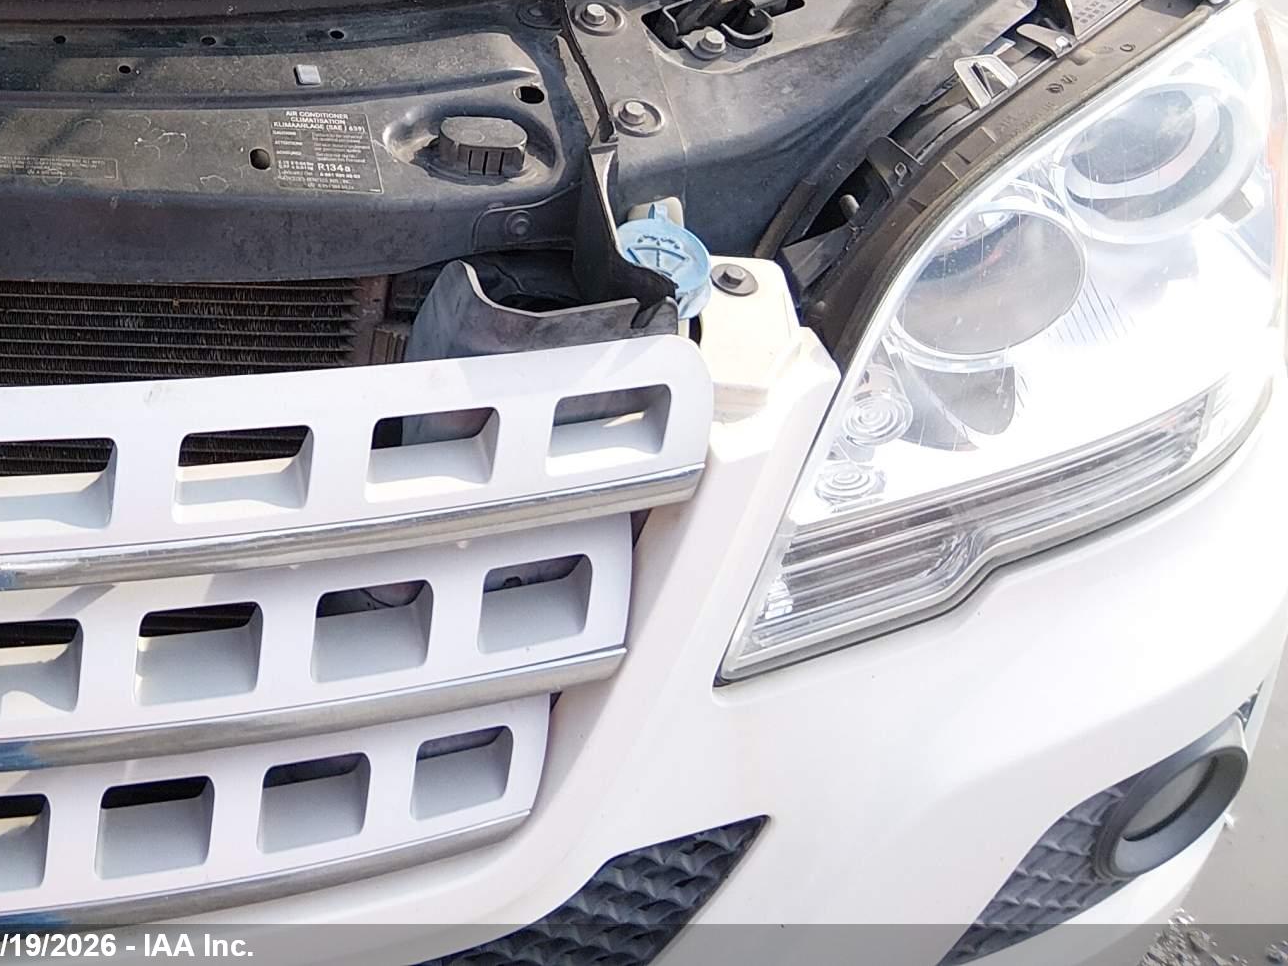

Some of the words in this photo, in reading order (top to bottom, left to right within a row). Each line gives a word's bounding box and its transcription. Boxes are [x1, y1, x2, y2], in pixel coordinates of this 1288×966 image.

[300, 111, 349, 120] CONDITIONER
[290, 116, 346, 125] CLIMATISATION
[273, 121, 325, 130] KLIMAANLAGE
[317, 162, 351, 172] R134a
